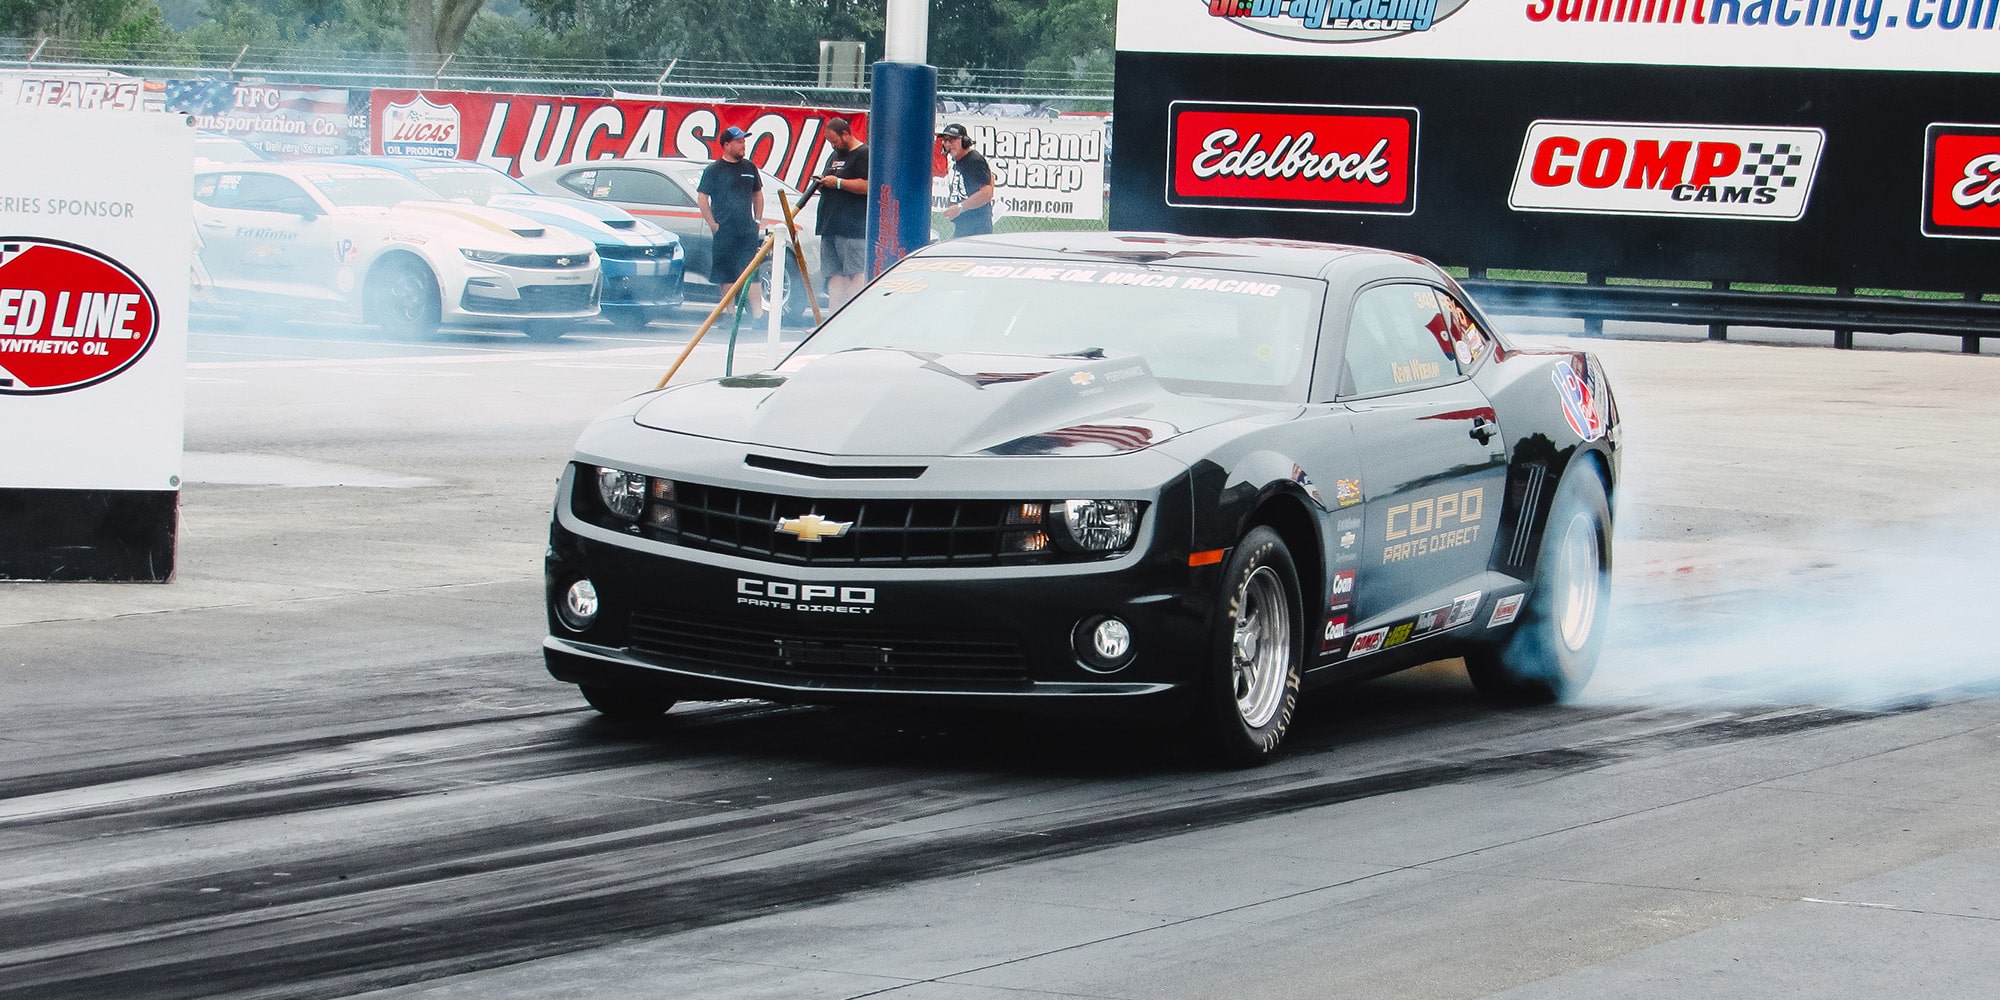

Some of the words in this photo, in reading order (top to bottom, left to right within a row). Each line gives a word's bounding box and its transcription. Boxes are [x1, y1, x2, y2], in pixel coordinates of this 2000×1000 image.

[1321, 17, 1413, 31] LEAGUE
[233, 87, 280, 110] TFC
[313, 117, 339, 136] Co.
[392, 123, 455, 142] LUCAS
[265, 142, 300, 155] Delivery
[387, 145, 402, 155] OIL
[405, 146, 454, 157] PRODUCTS
[475, 101, 718, 178] LUCAS
[974, 125, 1101, 162] Harland
[1192, 128, 1390, 184] Edelbrock
[1531, 136, 1742, 190] COMP
[990, 158, 1083, 191] Sharp
[1671, 184, 1778, 205] CAMS
[48, 199, 134, 218] SPONSOR
[963, 265, 1014, 278] RED
[1014, 266, 1062, 281] LINE
[1058, 269, 1099, 283] OIL
[1100, 270, 1179, 289] NMCA
[1180, 276, 1283, 298] RACING
[51, 290, 141, 340] LINE
[83, 341, 109, 356] OIL
[1386, 487, 1483, 541] COPO
[1382, 537, 1428, 565] PARTS
[1429, 524, 1480, 553] DIRECT
[737, 578, 875, 603] COPO
[737, 597, 791, 610] PARTS
[797, 603, 874, 614] DIRECT
